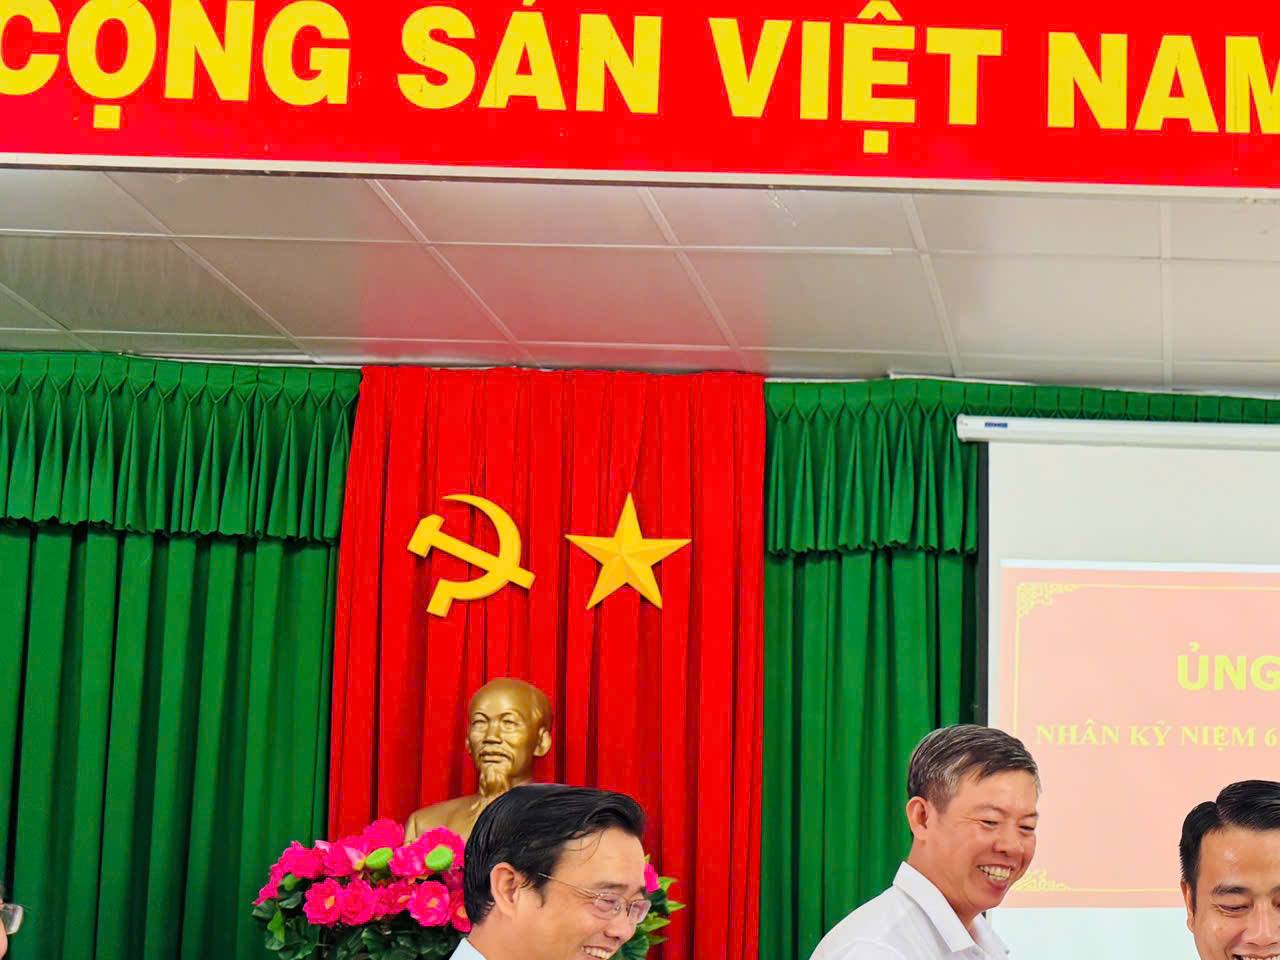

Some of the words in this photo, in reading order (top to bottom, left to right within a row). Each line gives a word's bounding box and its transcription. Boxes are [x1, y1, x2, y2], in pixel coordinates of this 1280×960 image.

[708, 0, 1002, 154] VIỆT
[1035, 719, 1121, 746] NHÂN
[1180, 723, 1258, 751] NIỆM
